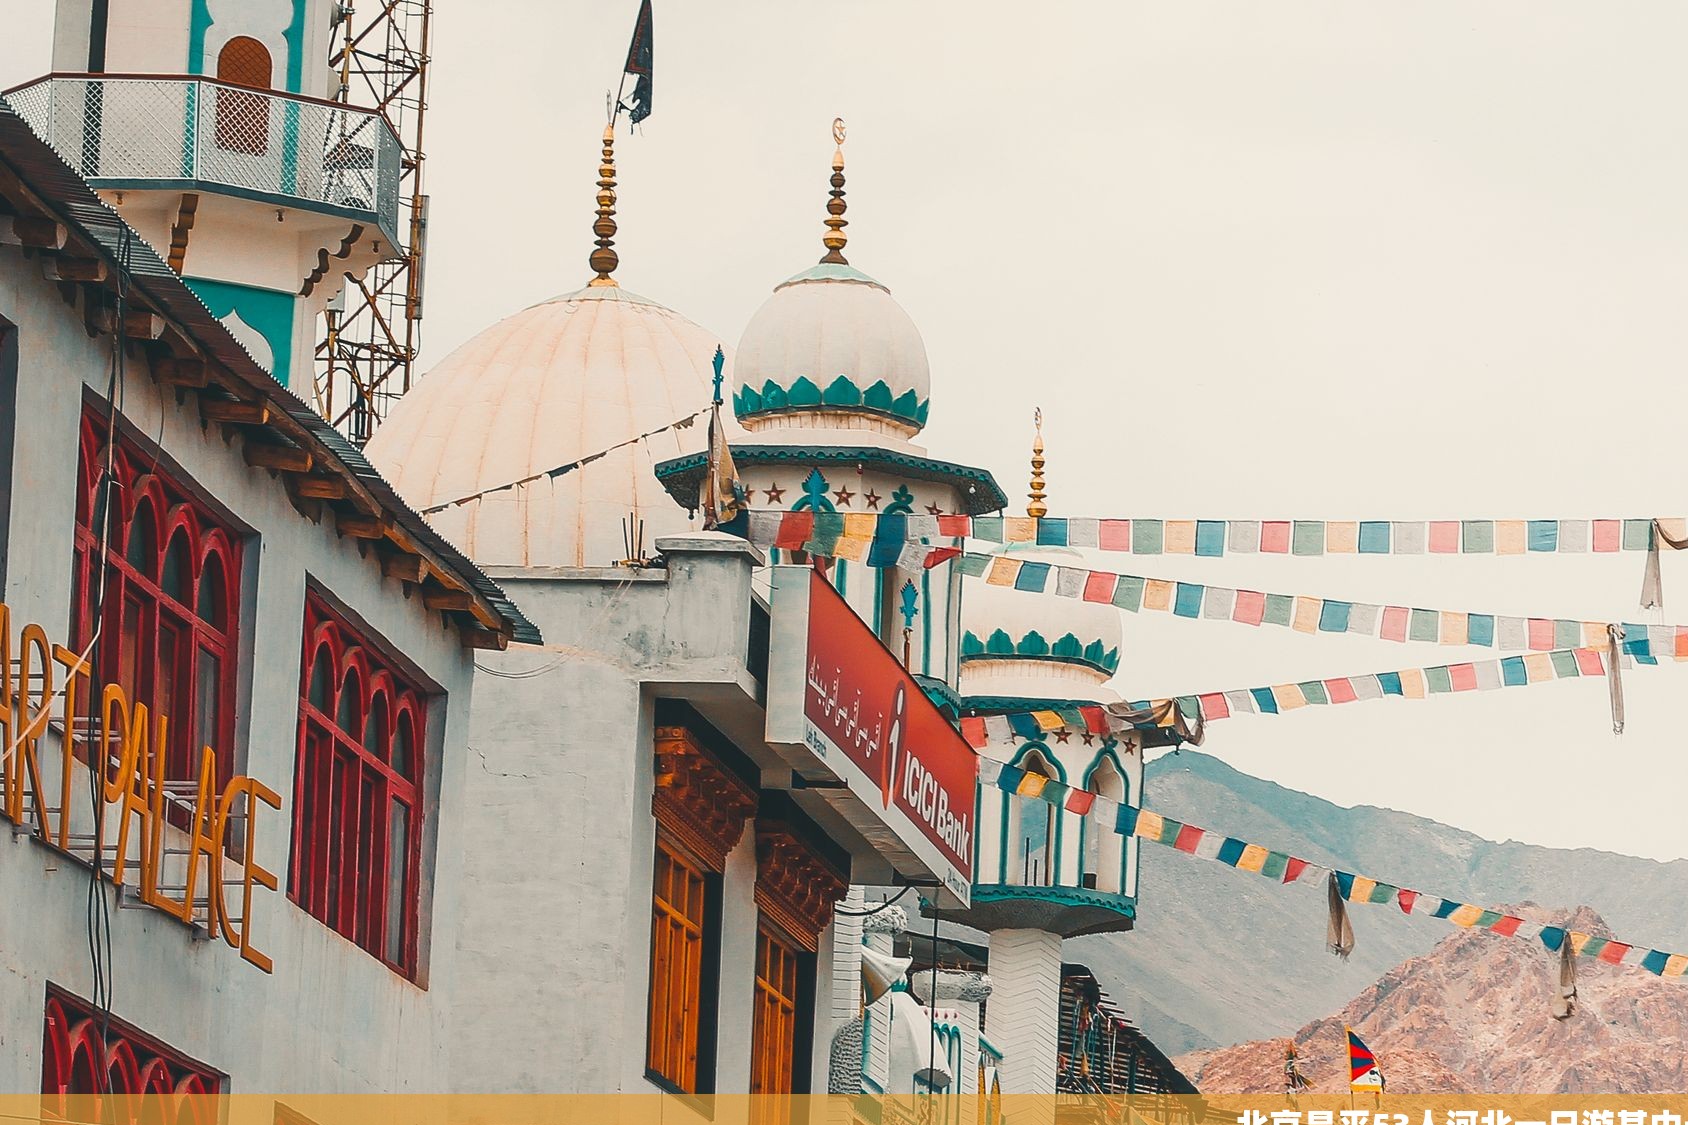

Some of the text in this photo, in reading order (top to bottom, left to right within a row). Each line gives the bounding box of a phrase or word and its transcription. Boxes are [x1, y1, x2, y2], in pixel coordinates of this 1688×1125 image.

[102, 683, 283, 975] PALACE
[903, 750, 970, 865] ICICI Bank
